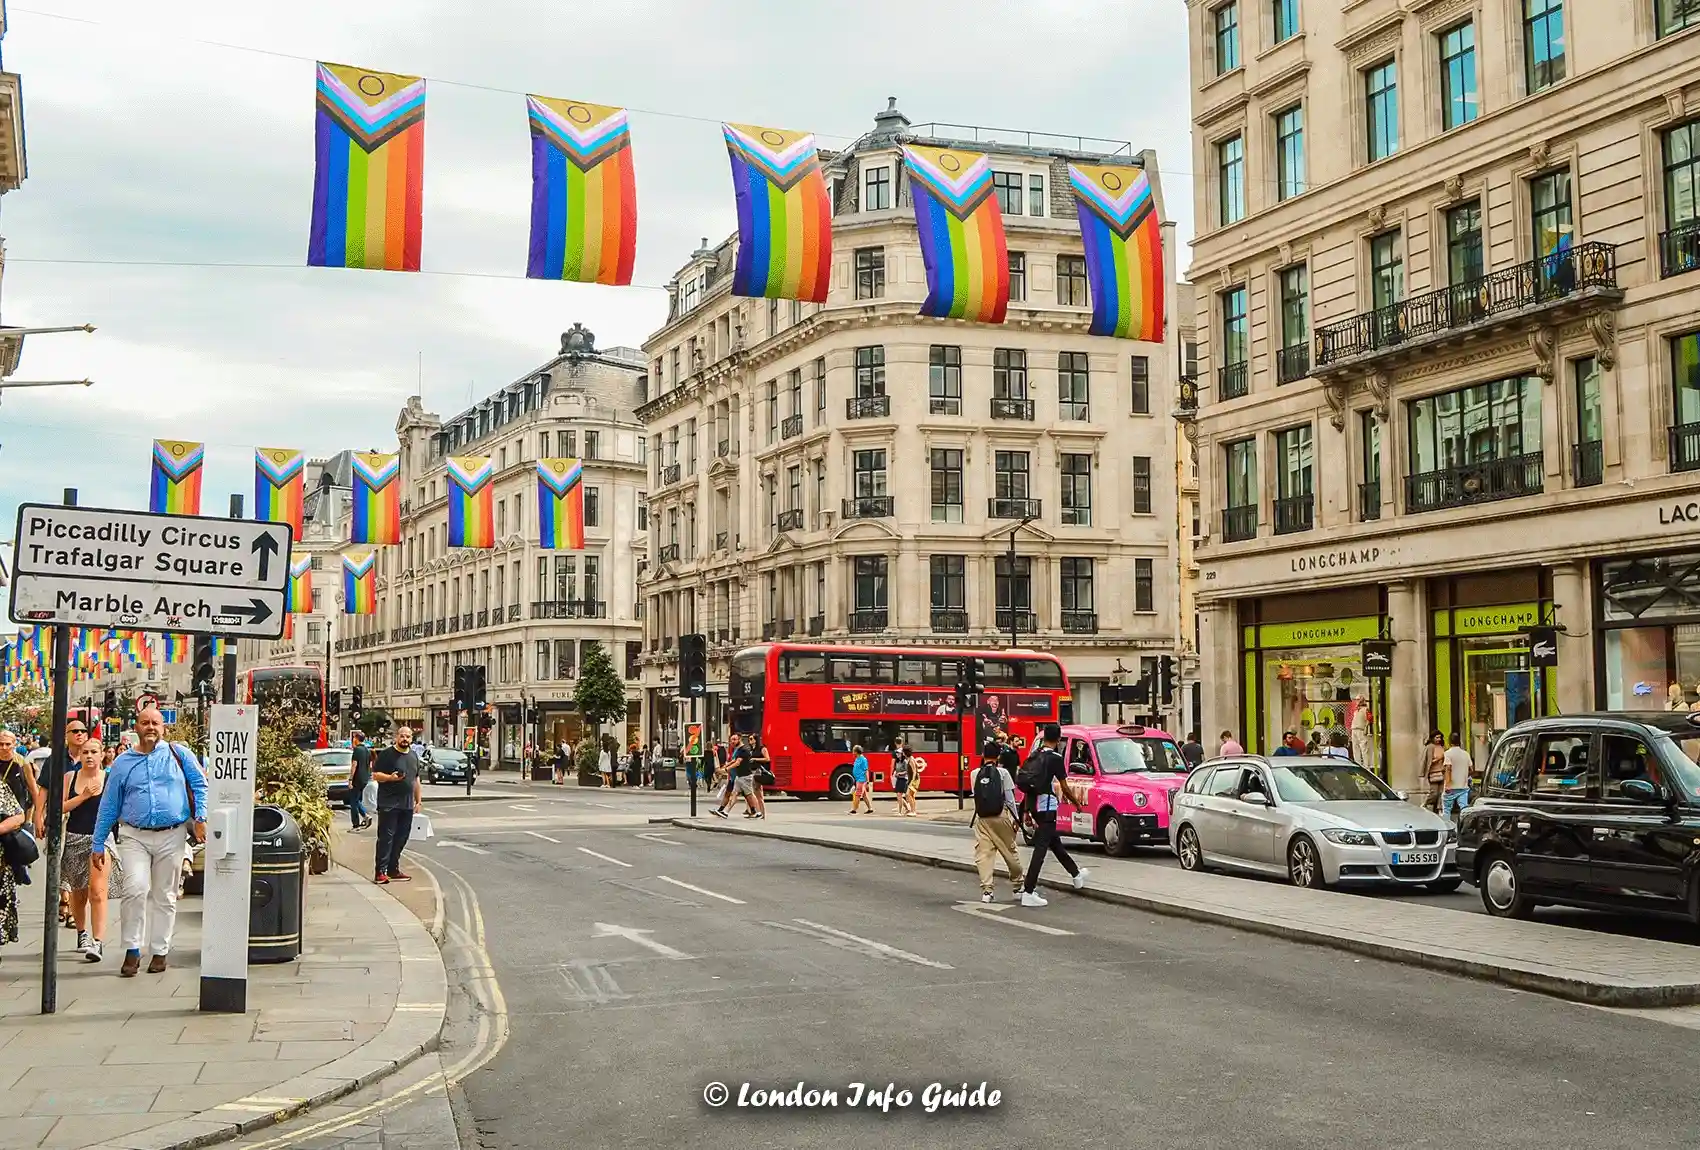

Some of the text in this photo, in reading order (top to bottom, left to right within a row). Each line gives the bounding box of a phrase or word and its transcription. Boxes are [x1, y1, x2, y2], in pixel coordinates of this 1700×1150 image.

[1660, 503, 1700, 524] LAC
[29, 517, 241, 550] Piccadilly Circus
[28, 544, 244, 576] Trafalgar Square
[1291, 548, 1380, 572] LONGCHAMP
[1205, 571, 1217, 580] 229
[55, 590, 212, 618] Marble Arch
[1464, 613, 1533, 627] LONGCHAMP
[1292, 627, 1346, 640] LONGCHAMP
[887, 698, 915, 706] Mondays
[216, 731, 249, 754] STAY
[214, 757, 248, 780] SAFE
[1398, 853, 1437, 863] LJ55 SXB
